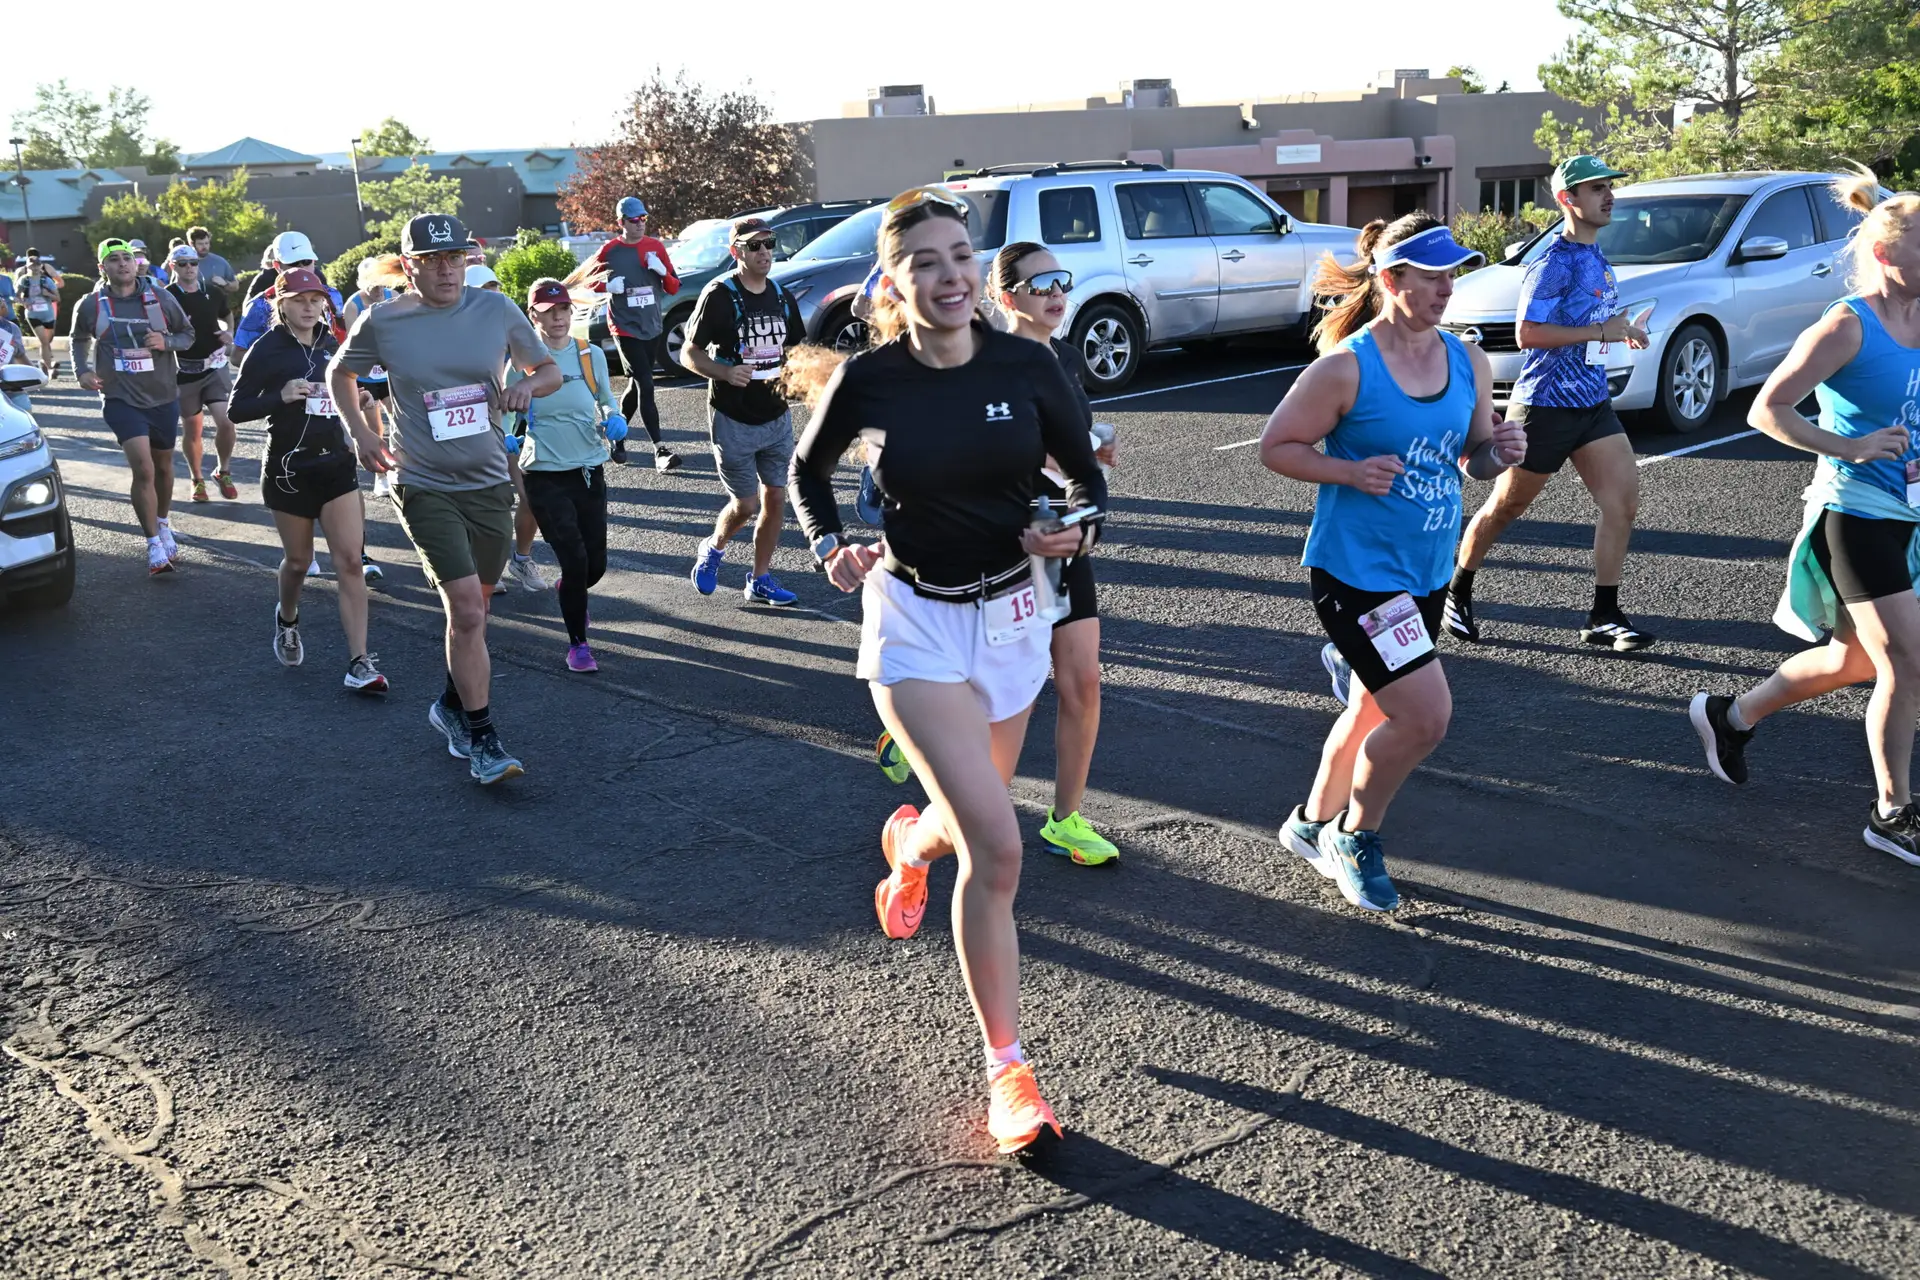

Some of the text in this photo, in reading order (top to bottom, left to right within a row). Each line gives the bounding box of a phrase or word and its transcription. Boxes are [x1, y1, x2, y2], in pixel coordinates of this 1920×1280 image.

[635, 296, 649, 305] 175
[445, 406, 477, 427] 232
[1423, 504, 1458, 532] 13.1
[1393, 617, 1424, 647] 057
